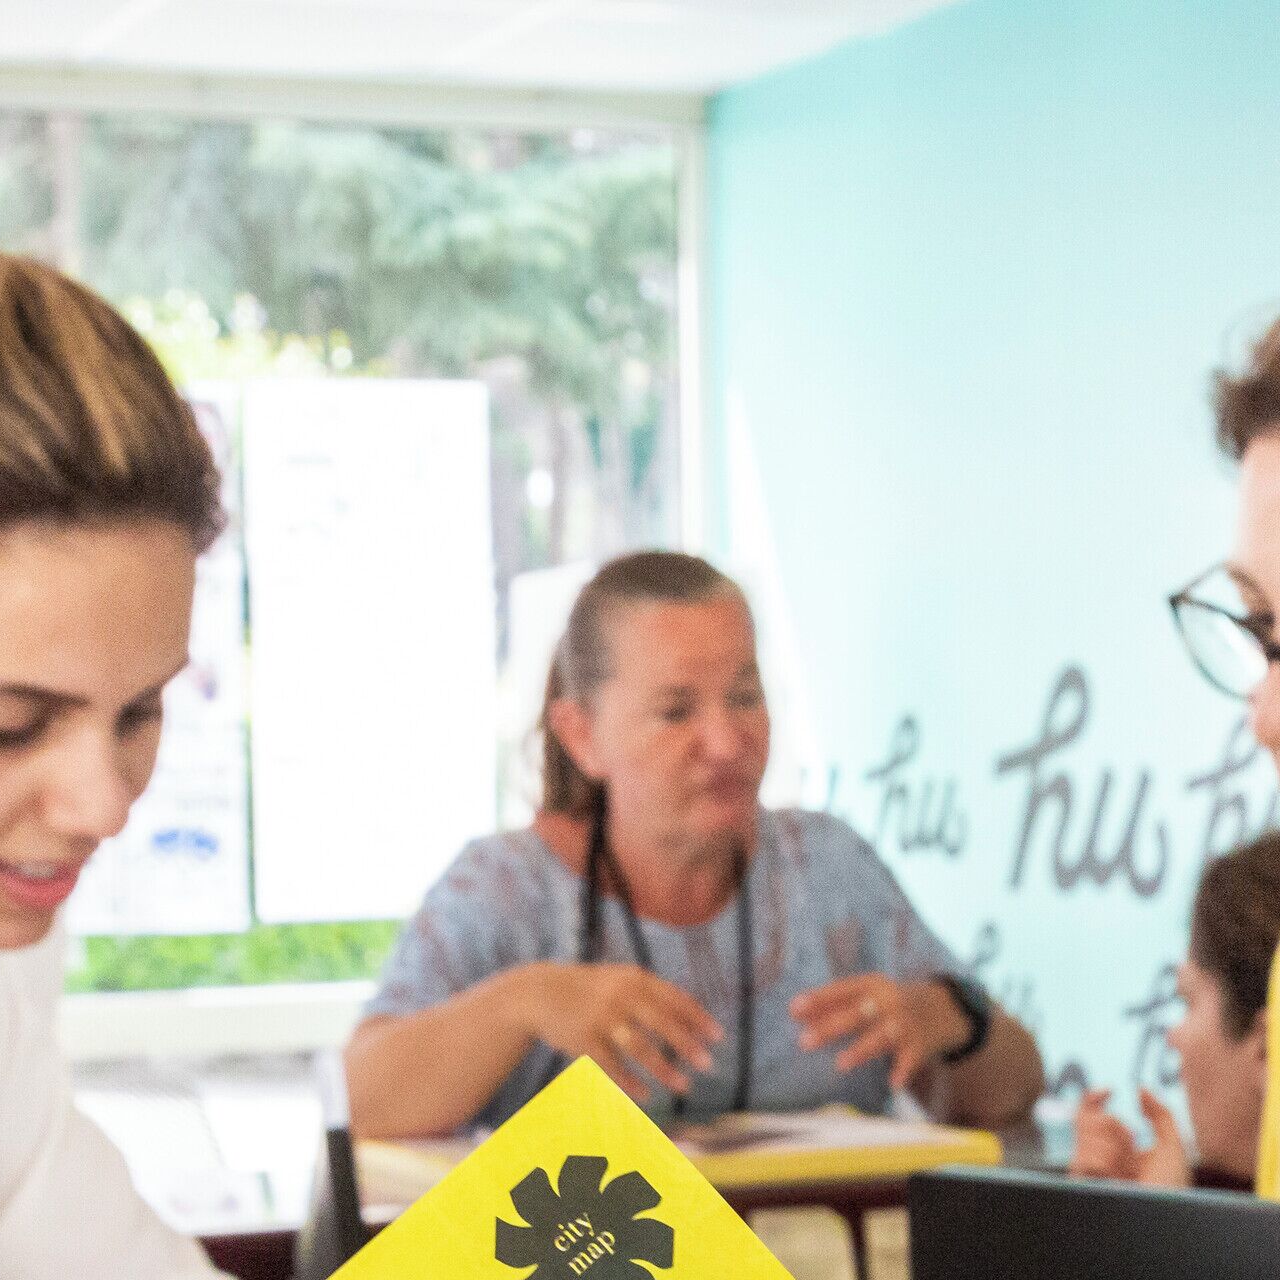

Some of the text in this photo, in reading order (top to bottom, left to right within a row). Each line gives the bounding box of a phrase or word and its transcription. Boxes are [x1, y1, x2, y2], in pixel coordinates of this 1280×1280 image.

[994, 663, 1173, 897] hu
[553, 1211, 596, 1253] city
[568, 1230, 616, 1277] map
